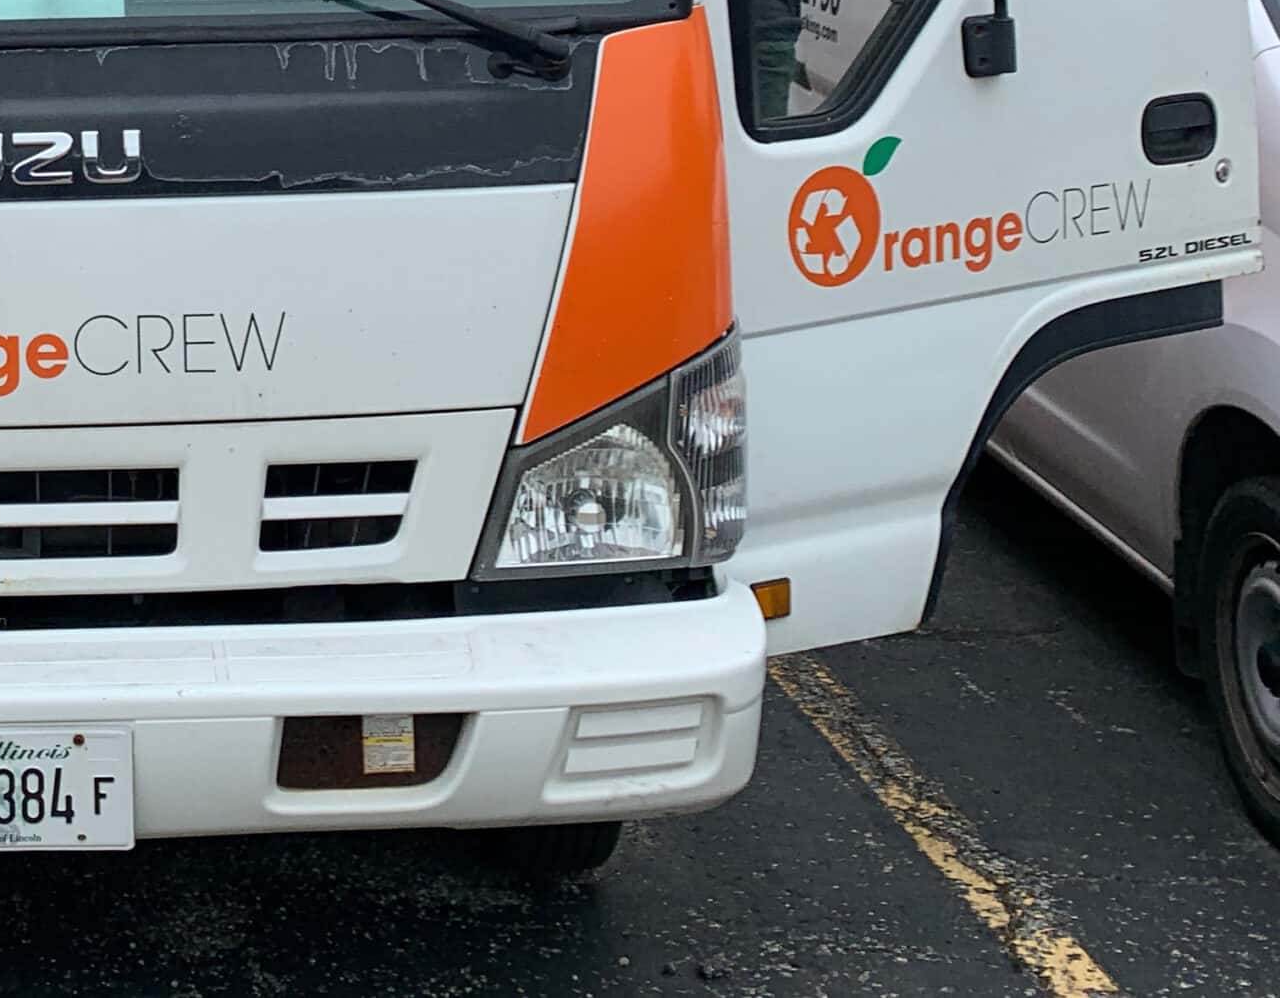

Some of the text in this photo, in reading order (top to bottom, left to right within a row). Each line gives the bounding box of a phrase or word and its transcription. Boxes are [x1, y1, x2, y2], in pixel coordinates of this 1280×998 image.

[1185, 232, 1252, 255] DIESEL
[93, 777, 115, 815] F
[9, 833, 42, 843] Lincoln
